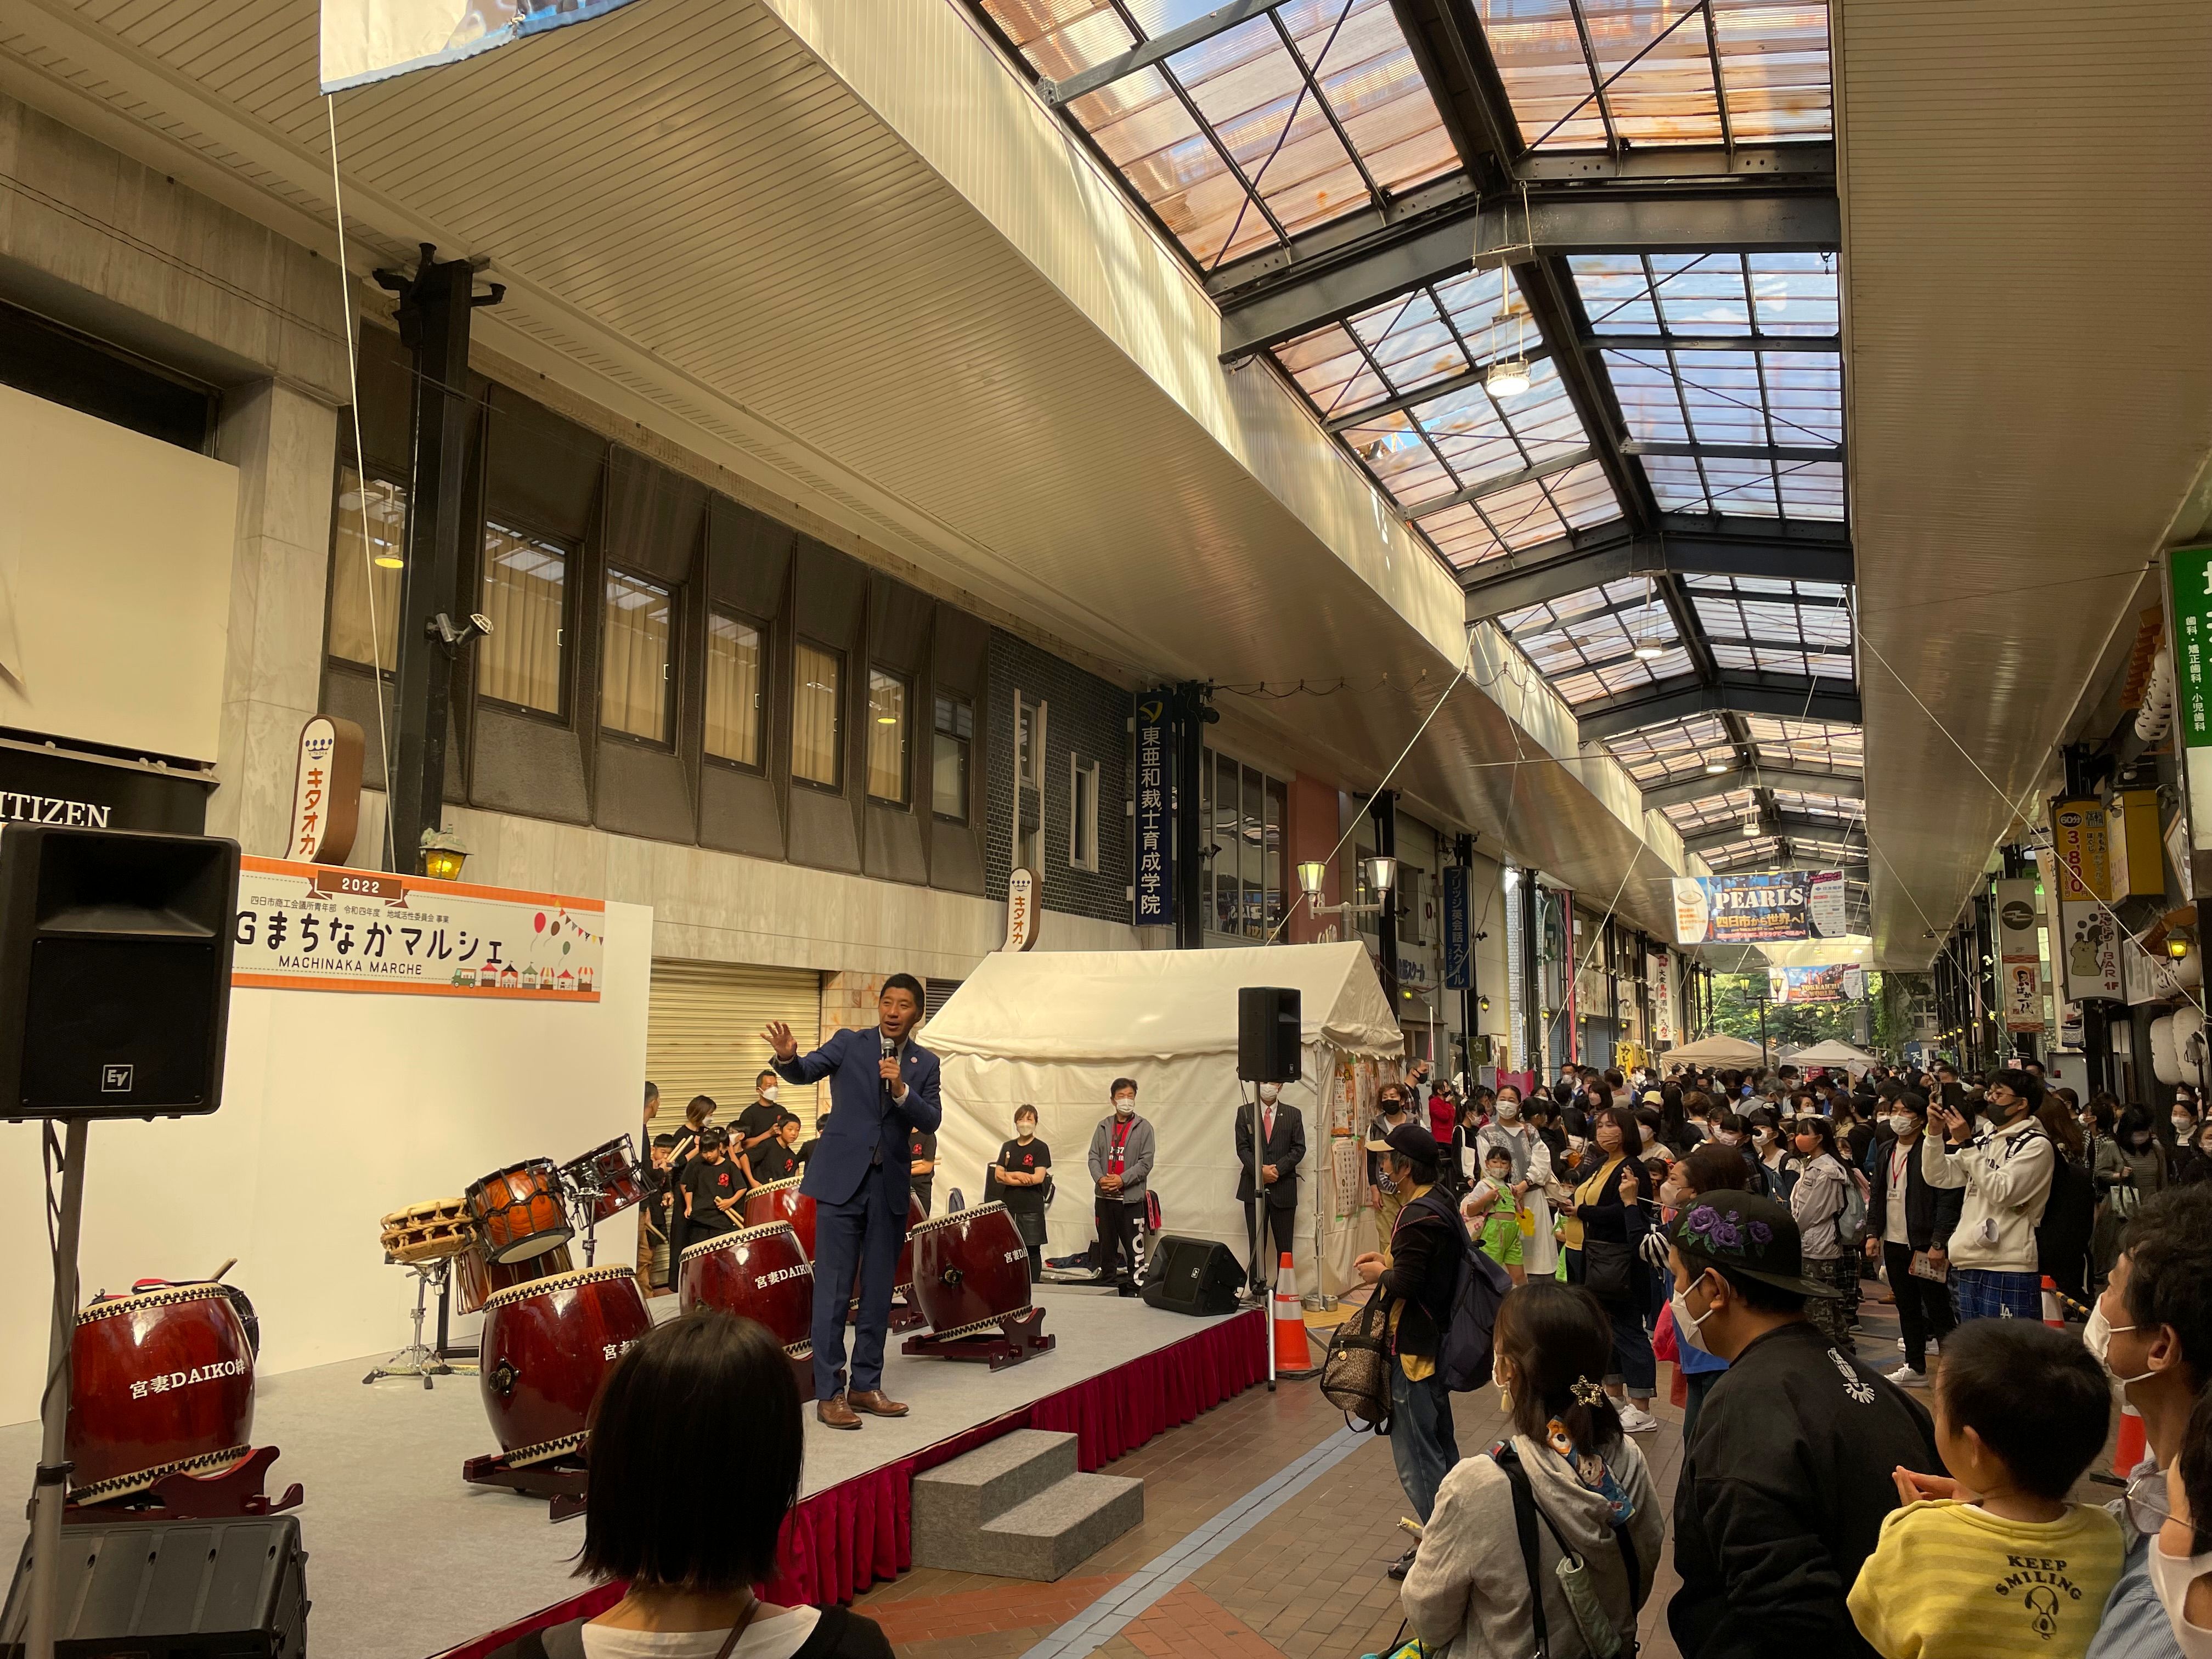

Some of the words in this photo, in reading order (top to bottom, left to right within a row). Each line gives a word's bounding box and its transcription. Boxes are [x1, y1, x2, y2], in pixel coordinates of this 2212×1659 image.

[2185, 616, 2205, 732] 歯科・矯正歯科・小児歯科
[299, 768, 324, 855] キタオカ
[1141, 726, 1163, 915] 東亜和裁士育成学院
[2060, 815, 2081, 824] 60分
[341, 877, 380, 894] 2022
[250, 895, 337, 912] 四日市商工会議所青年部
[343, 905, 381, 918] 令和四年度
[1714, 887, 1804, 910] PEARLS
[1012, 895, 1025, 944] キタオカ
[278, 955, 363, 972] MACHINAKA
[369, 961, 422, 975] MARCHE
[2104, 981, 2119, 990] 1F
[107, 1069, 129, 1087] EV
[129, 1358, 246, 1400] 宮妻DAIKO絆
[2006, 1554, 2067, 1571] KEEP
[1995, 1570, 2082, 1600] SMILING
